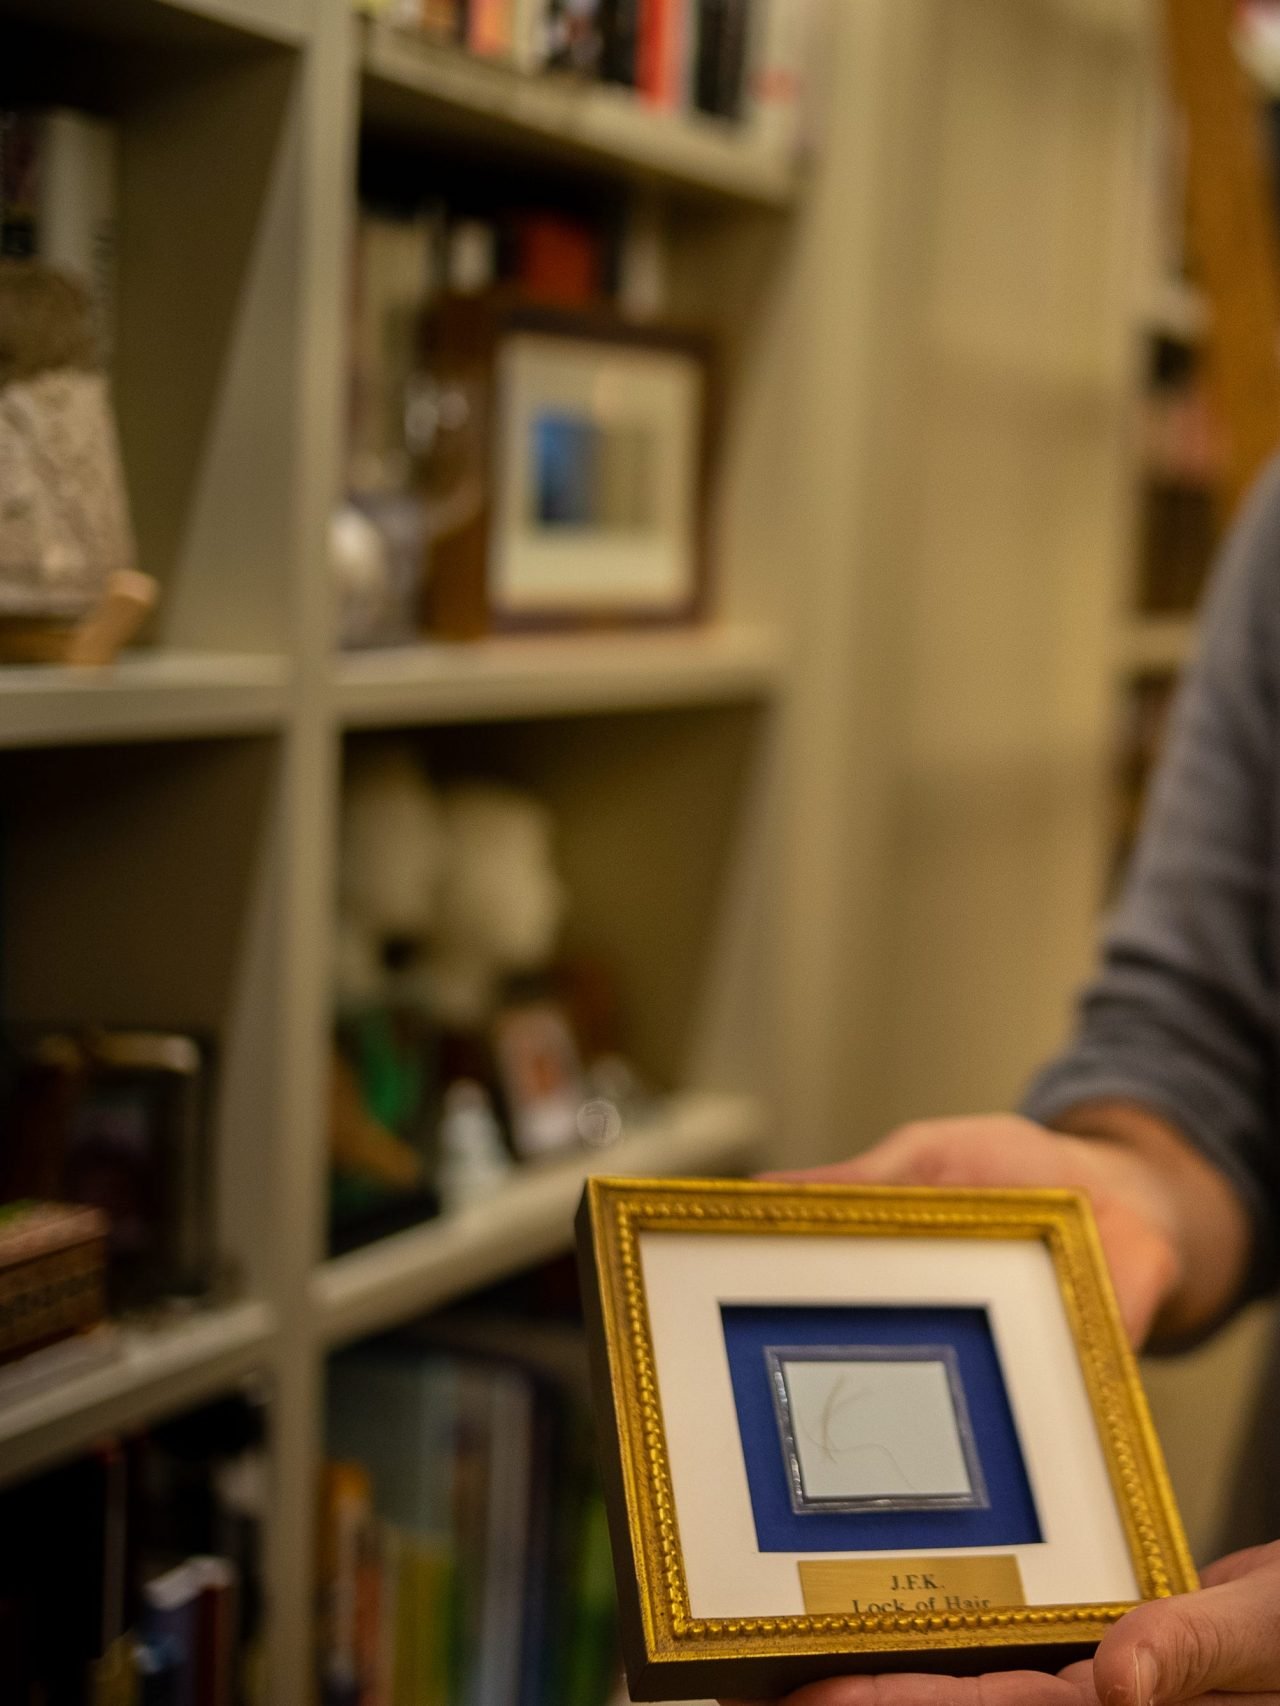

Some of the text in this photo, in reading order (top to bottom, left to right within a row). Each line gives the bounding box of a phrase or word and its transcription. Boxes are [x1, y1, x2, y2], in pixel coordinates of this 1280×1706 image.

[890, 1573, 945, 1591] J.F.K.
[851, 1595, 991, 1614] Lock of Hair
